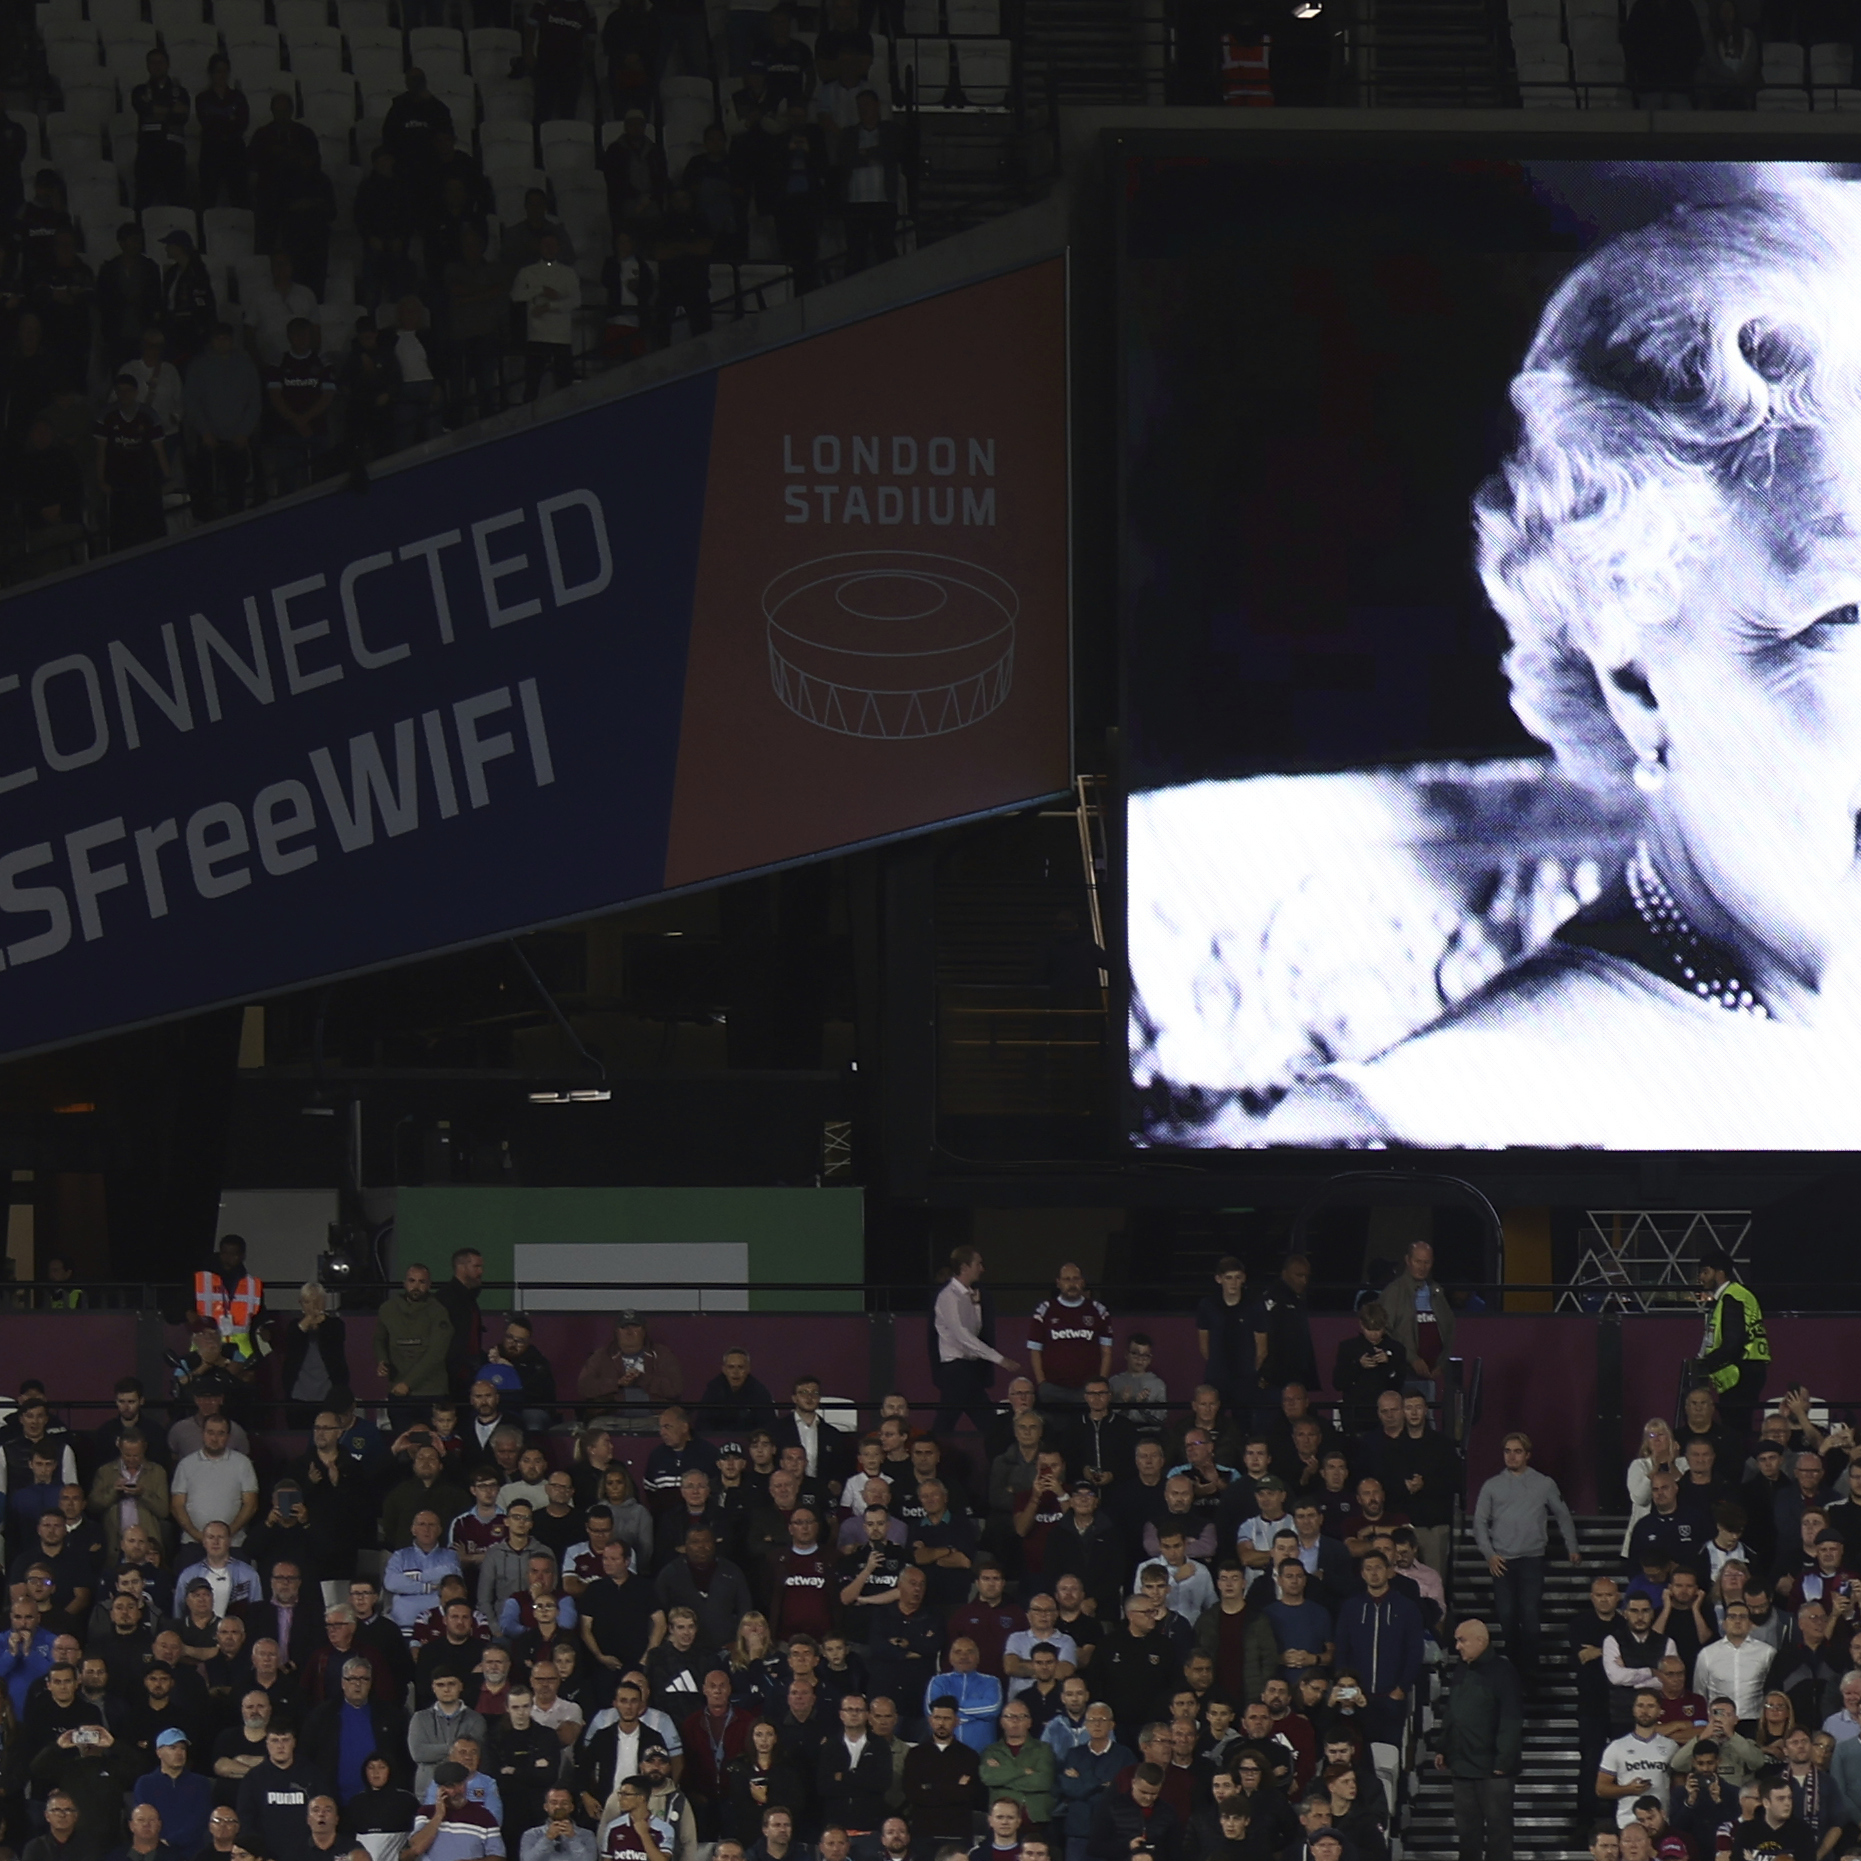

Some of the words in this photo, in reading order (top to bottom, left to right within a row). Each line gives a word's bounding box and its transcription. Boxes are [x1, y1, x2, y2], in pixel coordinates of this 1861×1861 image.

[783, 434, 996, 478] LONDON
[784, 485, 997, 528] STADIUM
[0, 677, 555, 972] SFreeWIFI
[1050, 1328, 1094, 1342] betway
[783, 1575, 824, 1588] etway
[267, 1791, 302, 1805] PUMA
